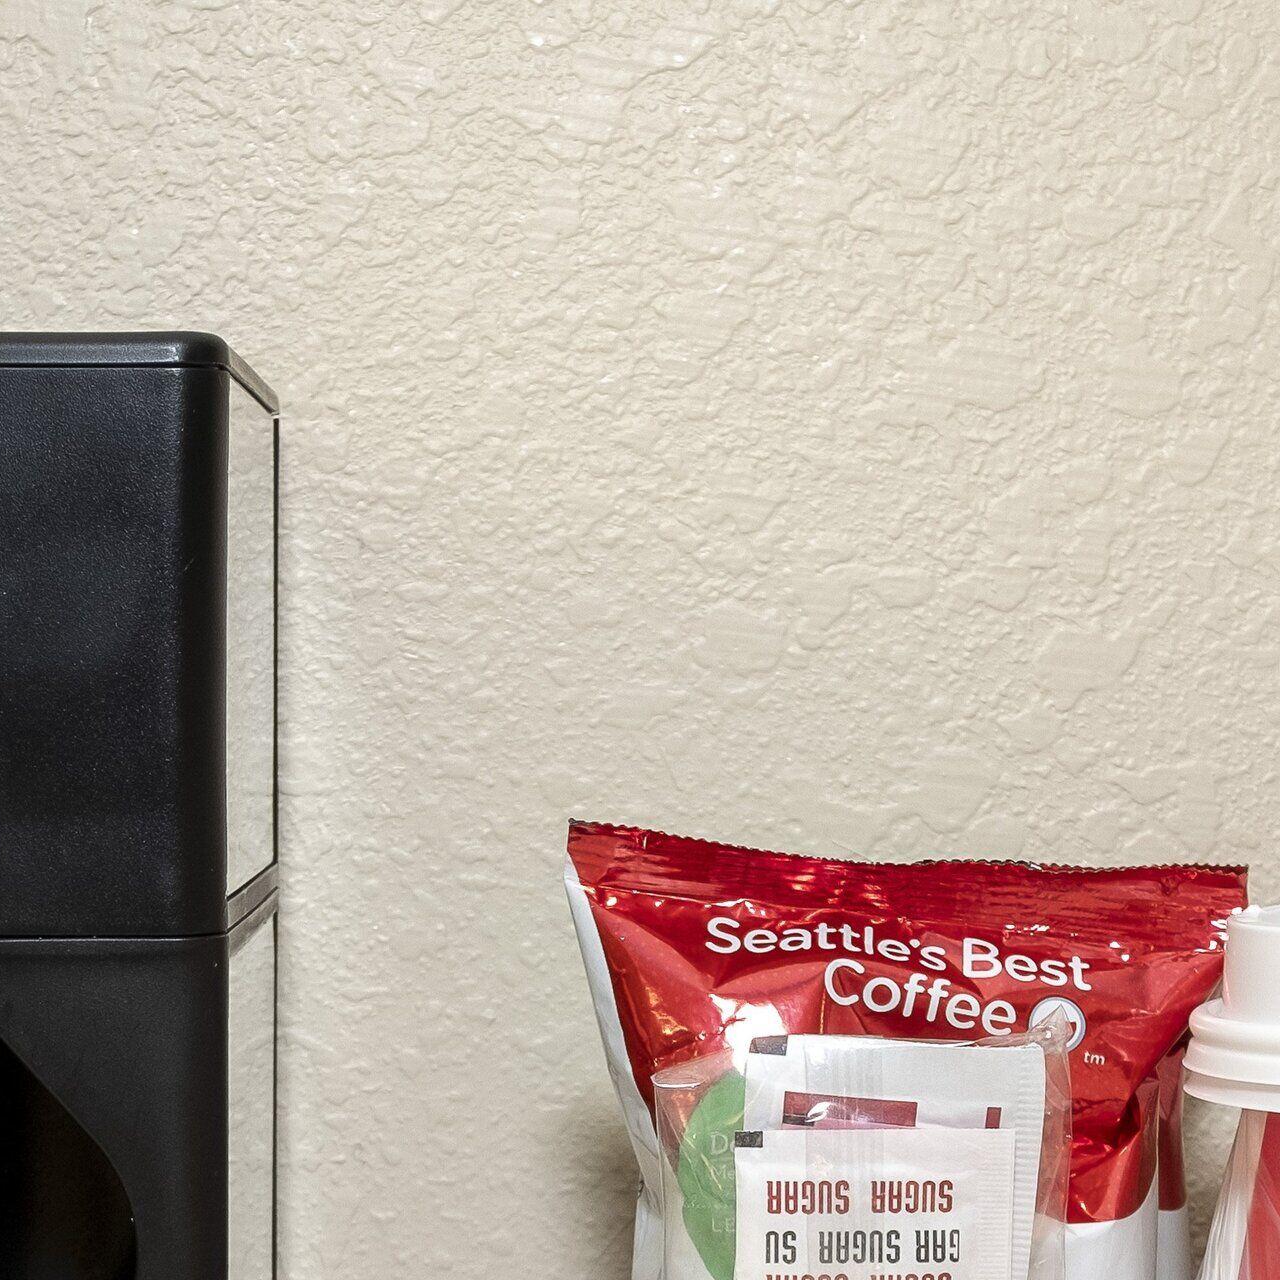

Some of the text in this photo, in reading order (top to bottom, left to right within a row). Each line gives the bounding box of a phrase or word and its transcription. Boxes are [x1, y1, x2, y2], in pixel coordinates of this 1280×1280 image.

[705, 916, 1092, 991] Seattle's Best
[824, 958, 1017, 1036] Coffee
[766, 1180, 954, 1215] SUGAR SUGAR
[765, 1229, 960, 1265] GAR SUGAR SU
